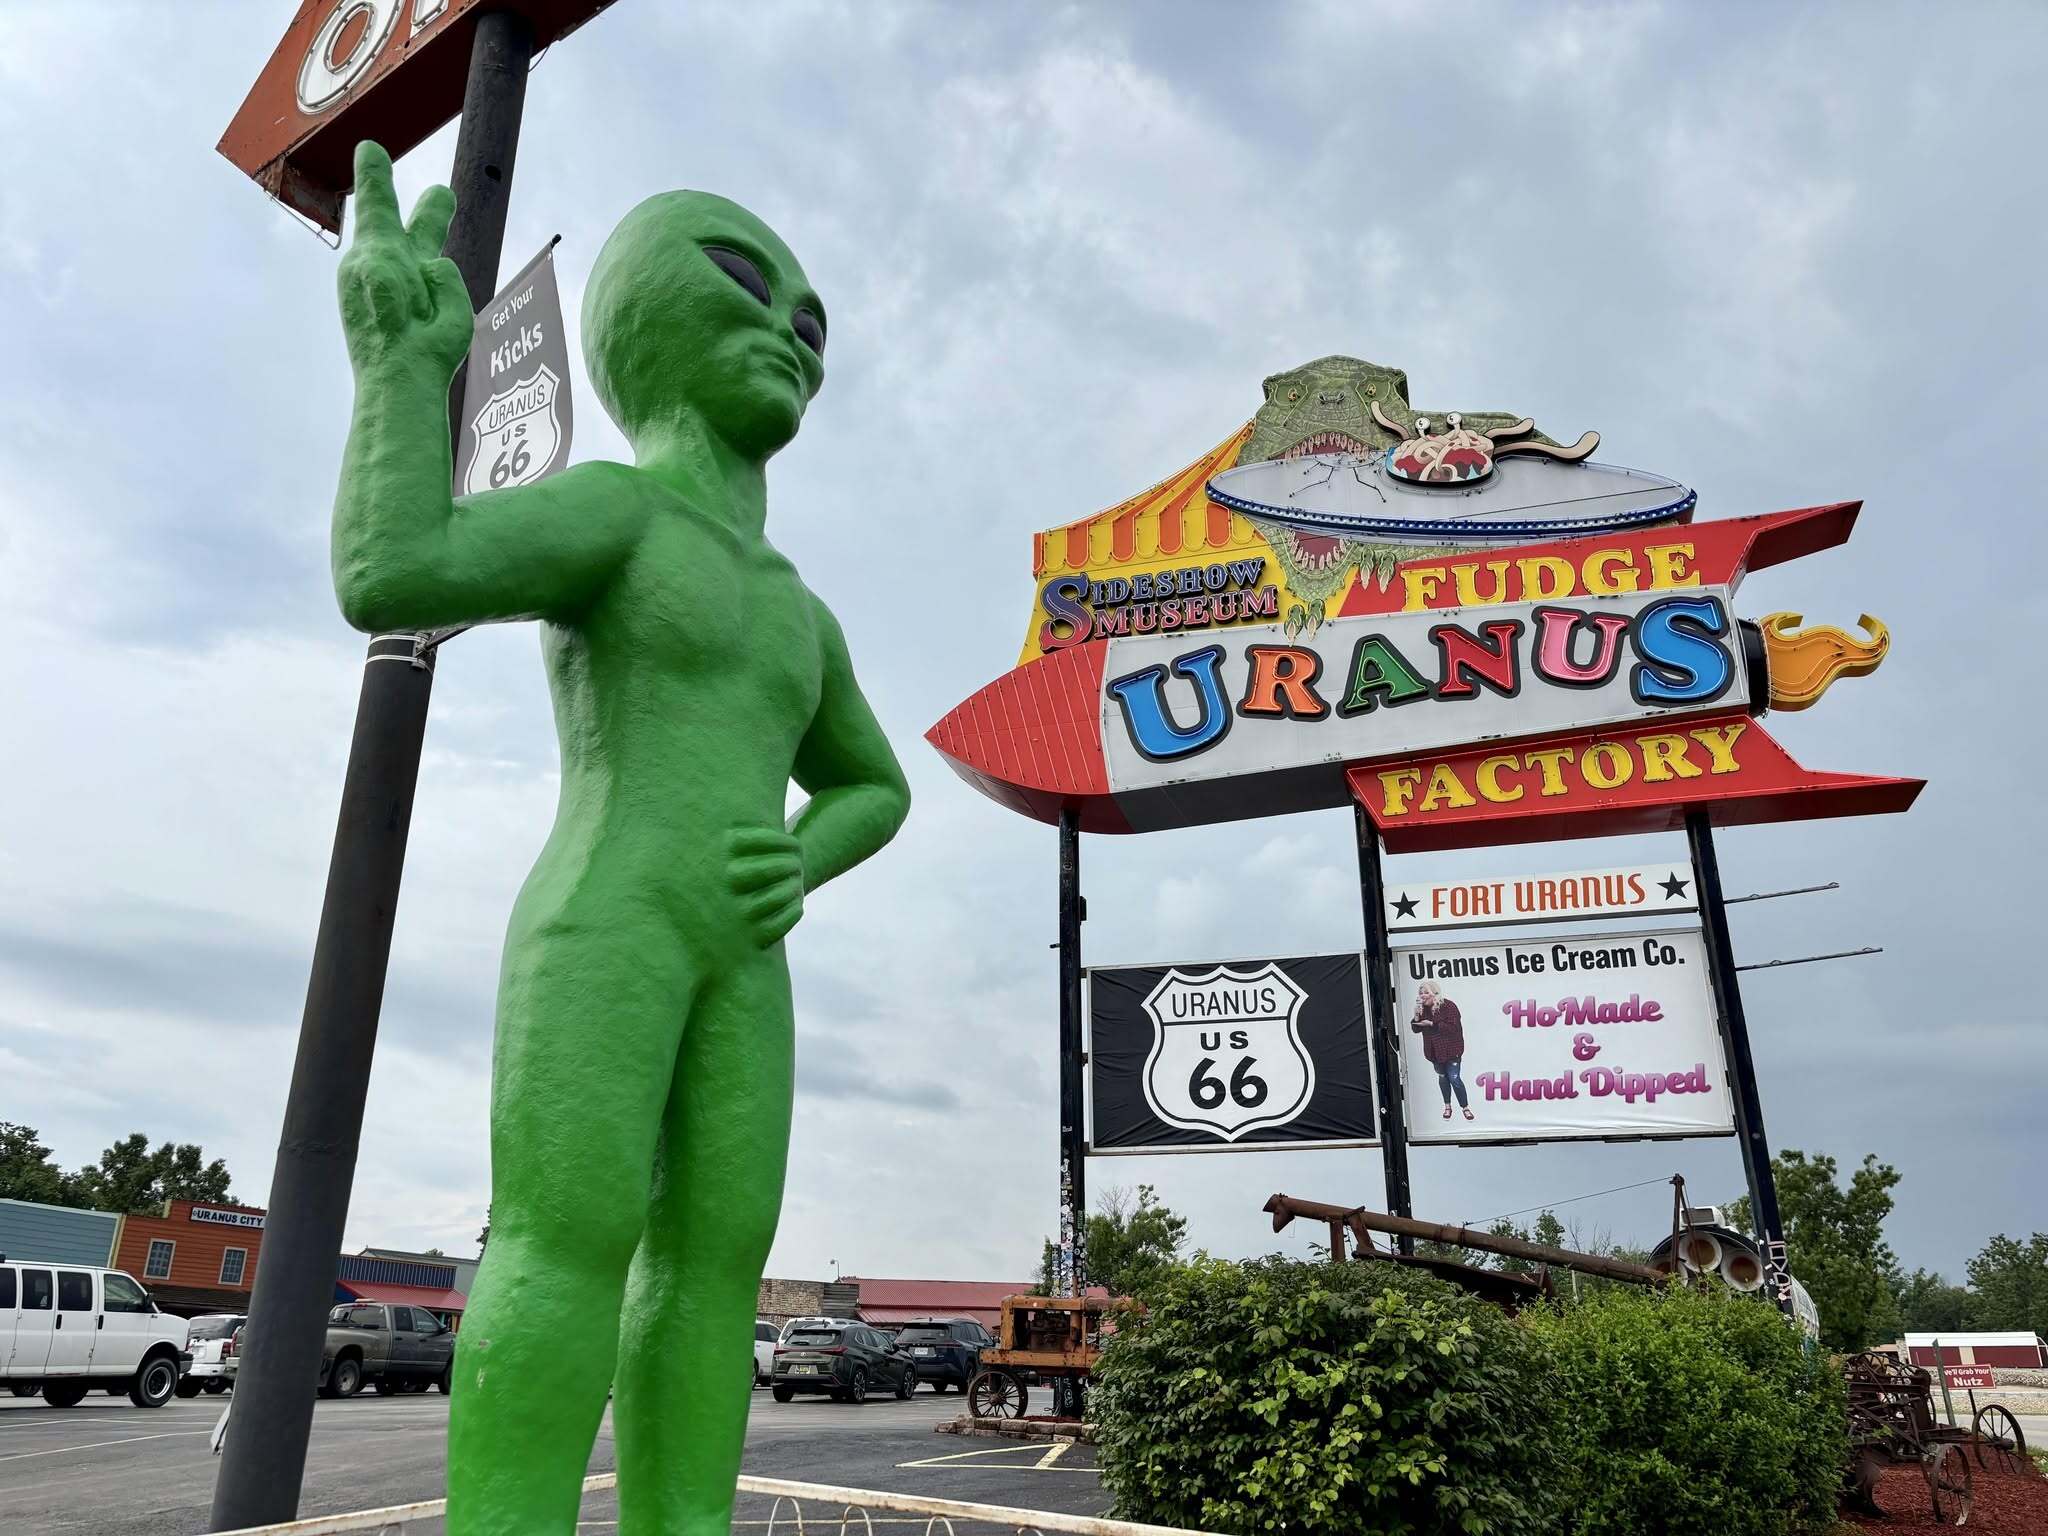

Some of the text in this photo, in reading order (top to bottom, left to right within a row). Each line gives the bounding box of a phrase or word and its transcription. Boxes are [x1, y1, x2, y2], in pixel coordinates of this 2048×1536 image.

[491, 285, 534, 331] Get Your
[490, 322, 544, 378] Kicks
[488, 383, 546, 429] URANUS
[489, 439, 532, 489] 66
[1400, 543, 1701, 611] FUDGE
[1038, 556, 1266, 652] SIDESHOW
[1094, 585, 1280, 641] MUSEUM
[1106, 594, 1737, 764] URANUS
[1376, 723, 1747, 817] FACTORY
[1432, 873, 1646, 919] FORT URANUS
[1408, 938, 1685, 980] Uranus Ice Cream Co.
[1172, 987, 1277, 1018] URANUS
[1502, 993, 1664, 1029] HoMade
[1572, 1032, 1602, 1061] &
[1188, 1055, 1269, 1110] 66
[1476, 1063, 1712, 1105] Hand Dipped
[197, 1210, 263, 1226] URANUS CITY
[1953, 1377, 1984, 1387] Nutz
[1958, 1368, 1974, 1376] Grab
